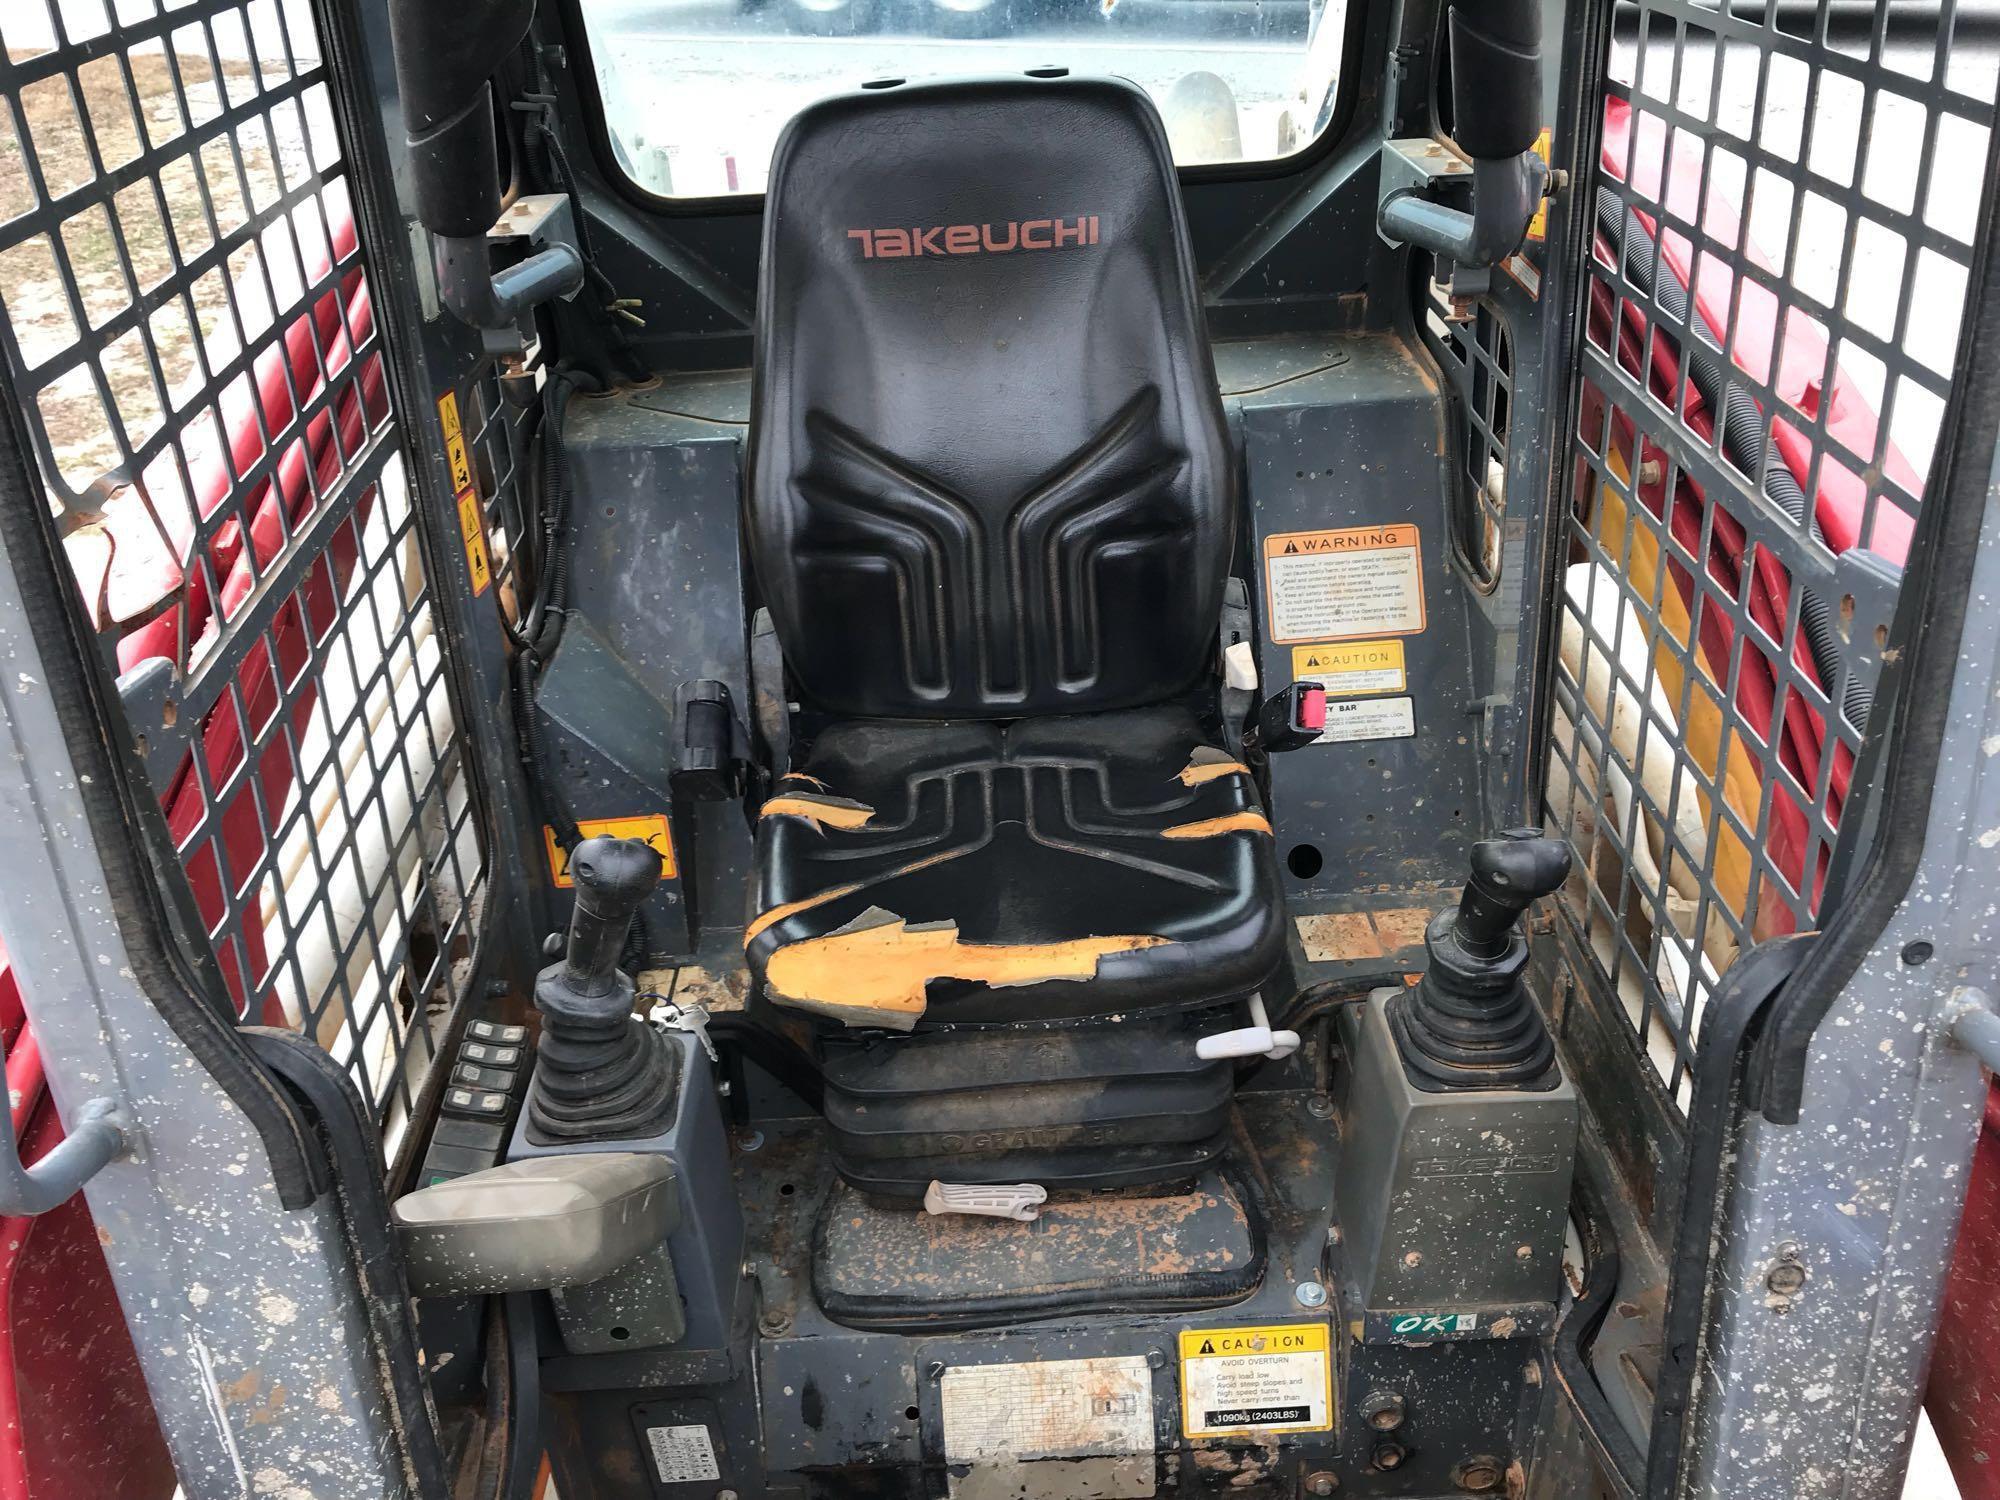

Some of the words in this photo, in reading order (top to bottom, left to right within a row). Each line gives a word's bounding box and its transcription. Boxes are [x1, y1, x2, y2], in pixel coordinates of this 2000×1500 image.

[1303, 533, 1397, 550] WARNING
[1322, 653, 1389, 666] CAUTION
[1395, 1314, 1454, 1333] OK
[1249, 1357, 1289, 1365] OVERTURN
[1238, 1371, 1254, 1379] load
[1217, 1414, 1251, 1423] 1090kg
[1252, 1410, 1299, 1421] (2403LBS)
